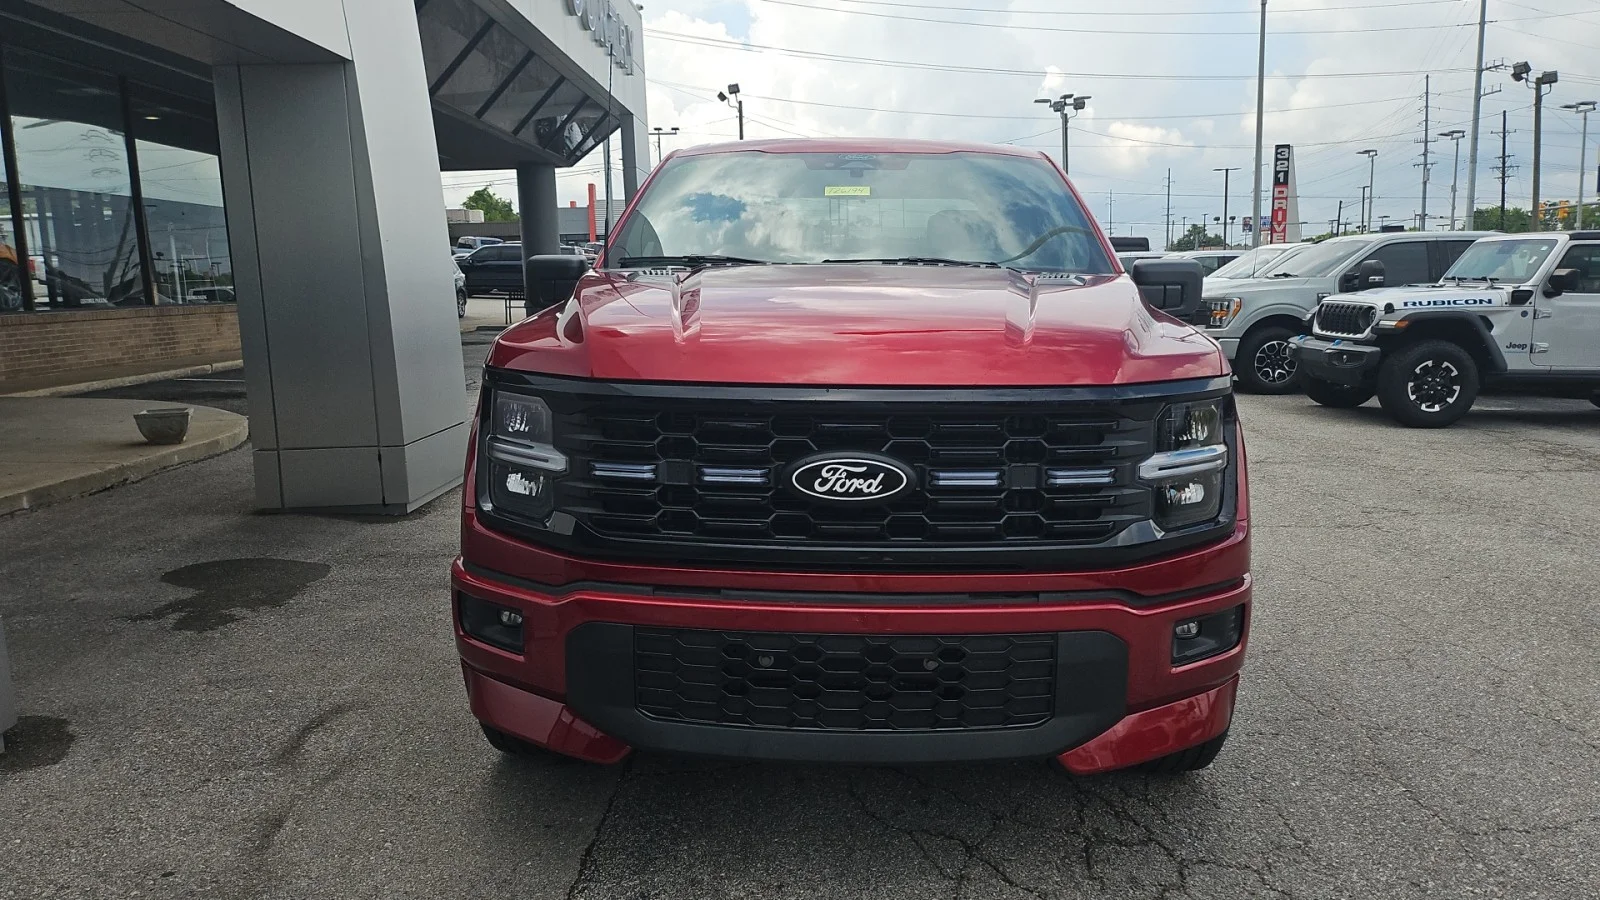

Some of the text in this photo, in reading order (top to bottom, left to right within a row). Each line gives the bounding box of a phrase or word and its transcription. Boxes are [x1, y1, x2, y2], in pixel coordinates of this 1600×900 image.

[1272, 148, 1289, 243] 321 DRIVE
[1403, 298, 1493, 307] RUBICON
[1505, 342, 1528, 351] Jeep
[814, 464, 885, 493] Ford
